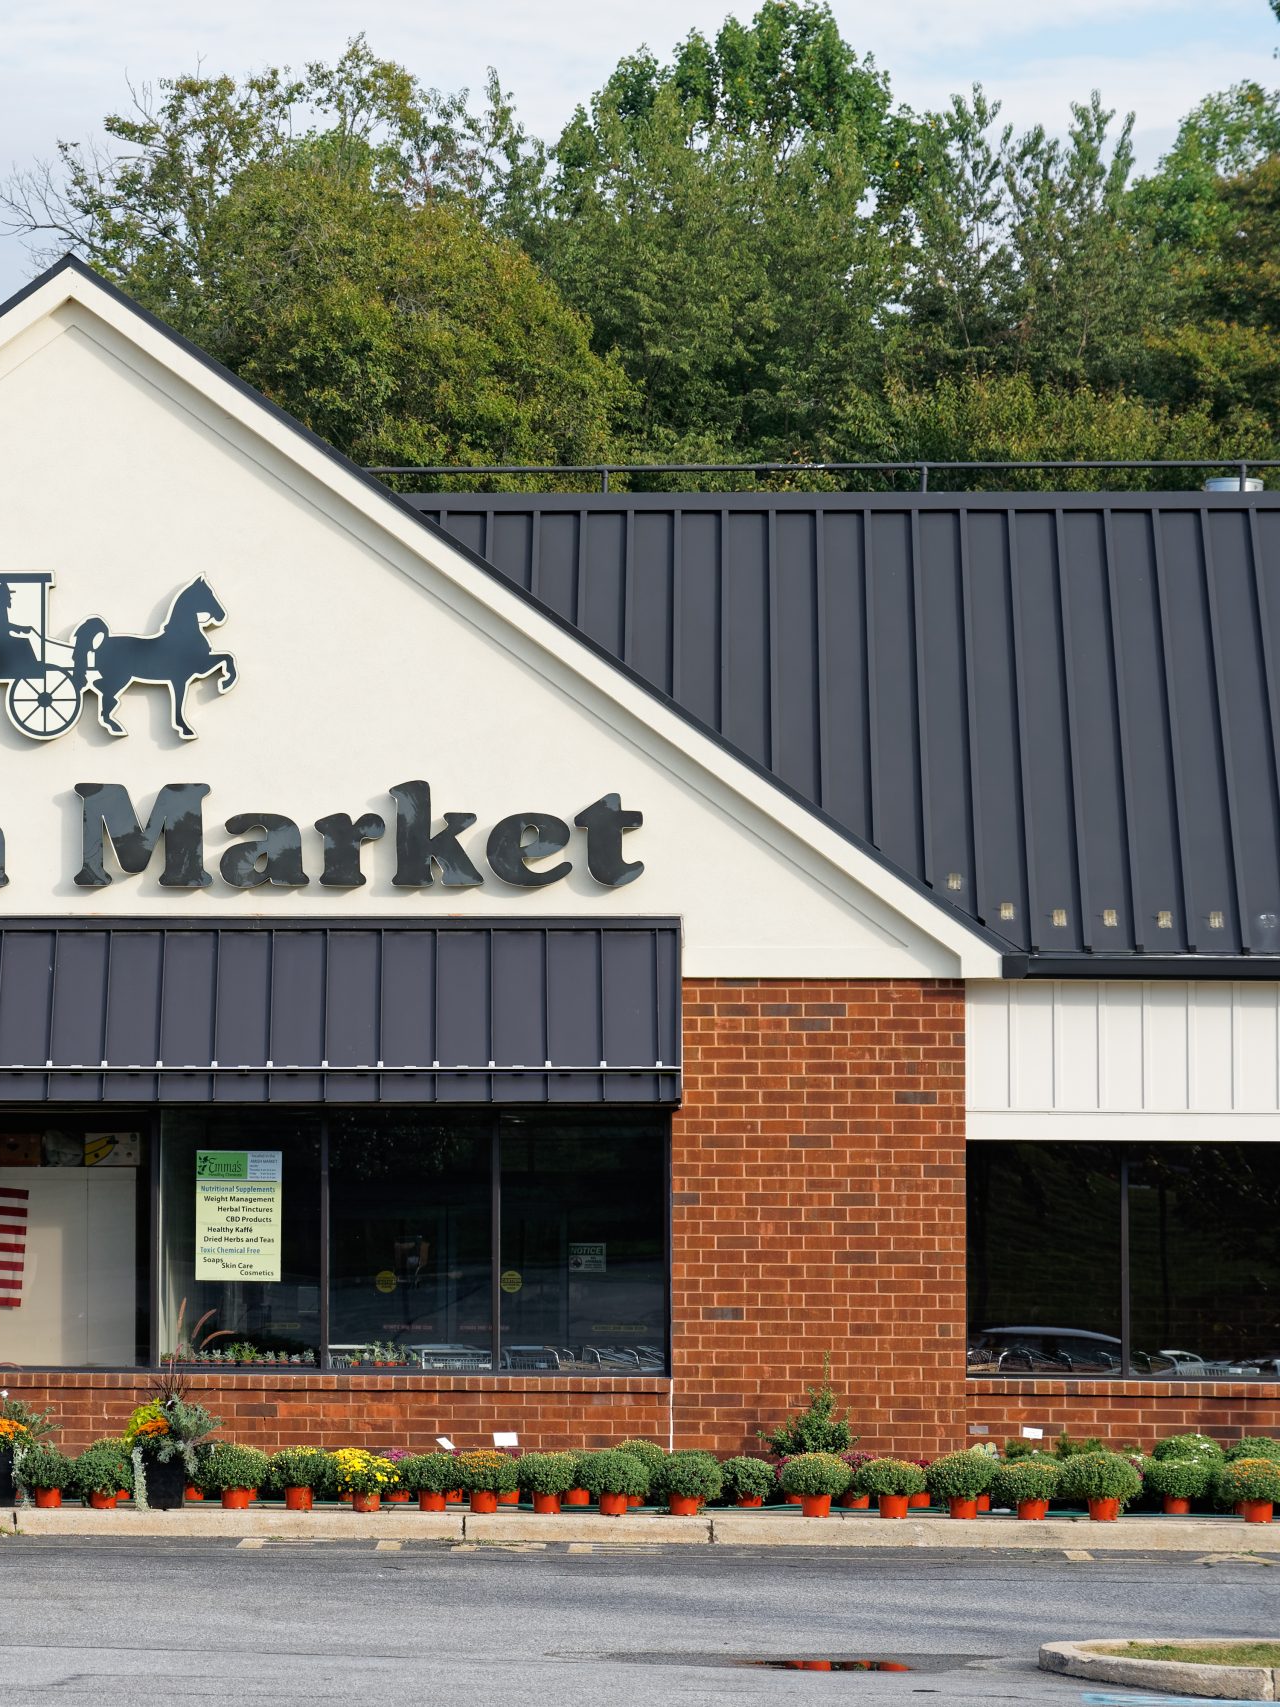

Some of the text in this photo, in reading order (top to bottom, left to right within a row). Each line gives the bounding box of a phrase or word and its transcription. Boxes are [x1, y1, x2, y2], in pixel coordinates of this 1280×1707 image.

[70, 780, 646, 889] Market
[208, 1157, 242, 1173] Emma's
[201, 1185, 275, 1194] Nutritional Supplements
[229, 1196, 274, 1204] Management
